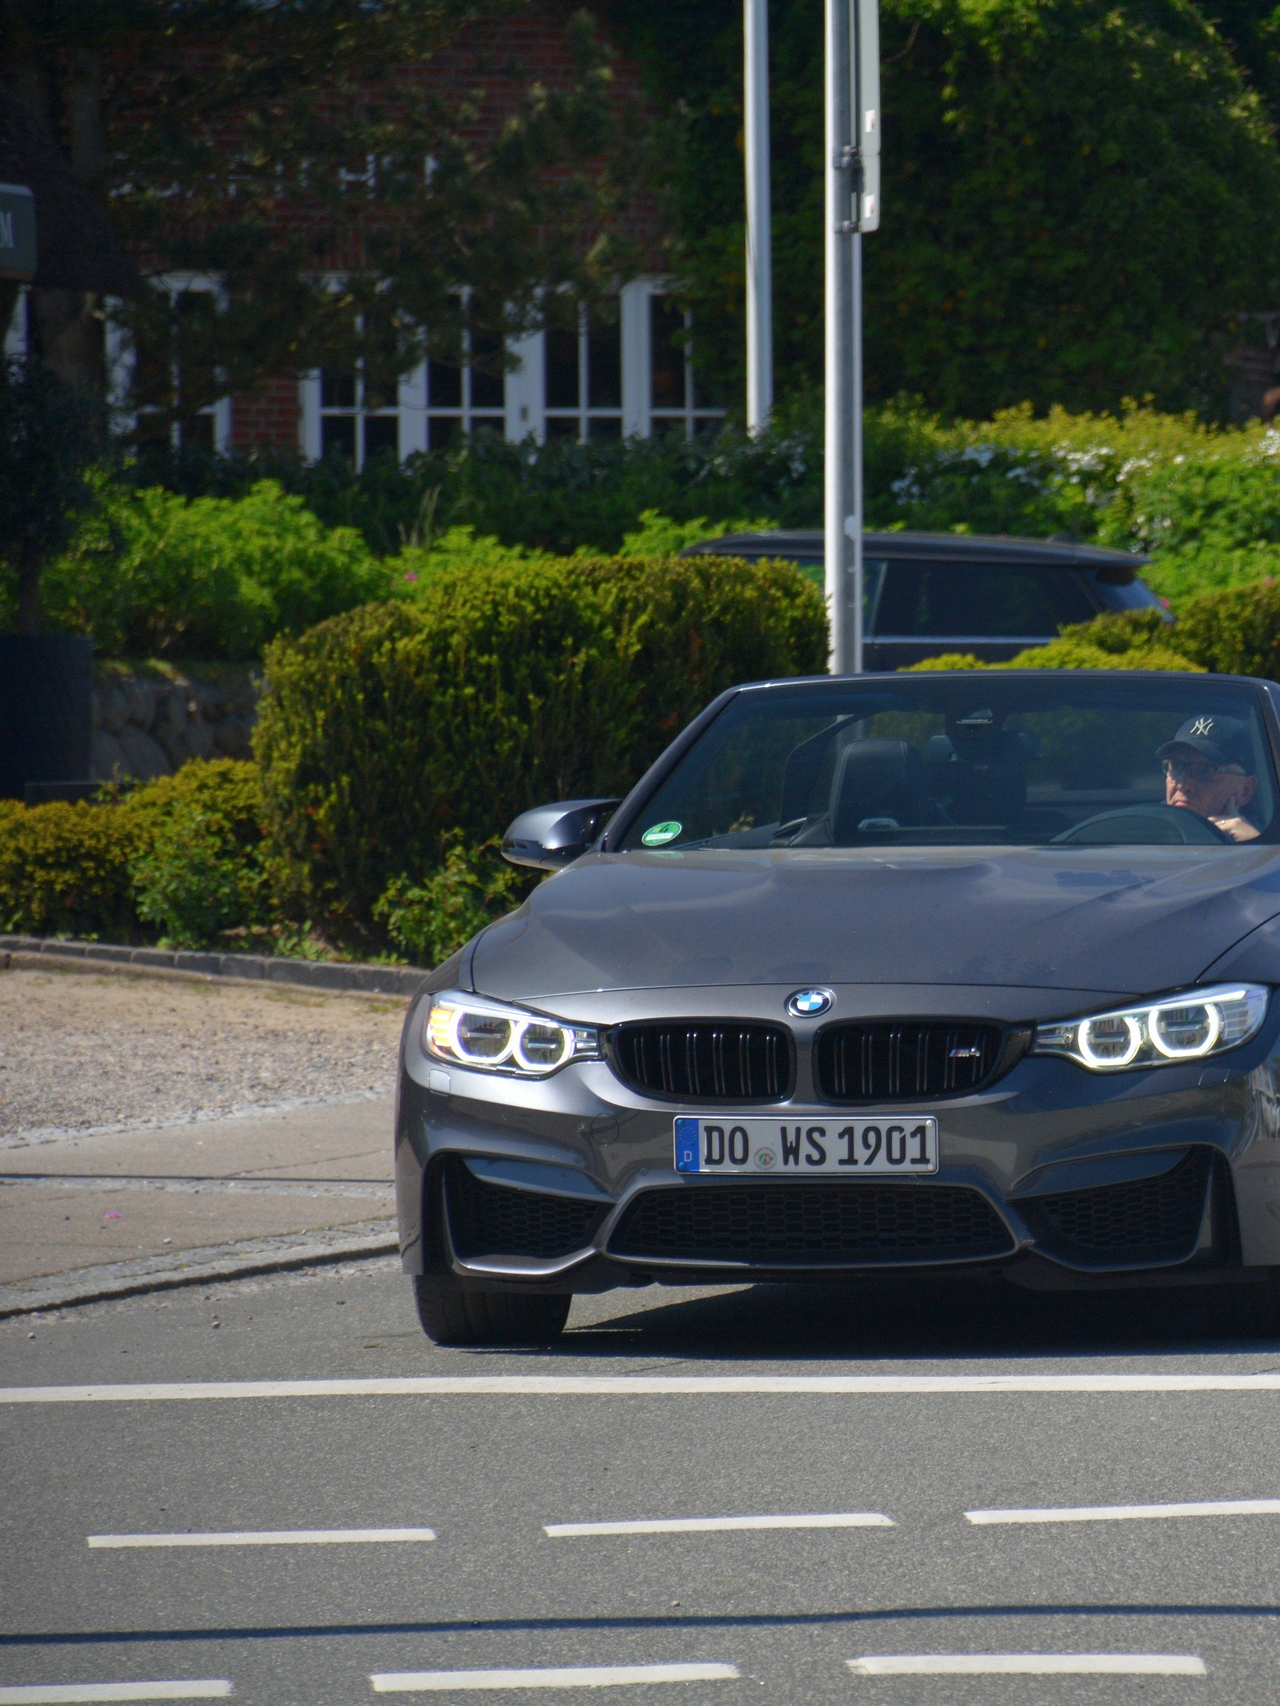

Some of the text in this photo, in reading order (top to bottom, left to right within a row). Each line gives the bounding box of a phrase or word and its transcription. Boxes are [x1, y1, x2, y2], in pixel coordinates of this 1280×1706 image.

[1190, 717, 1214, 736] NY
[704, 1126, 749, 1165] DO
[780, 1126, 827, 1166] WS
[838, 1125, 931, 1166] 1901
[683, 1151, 692, 1162] D
